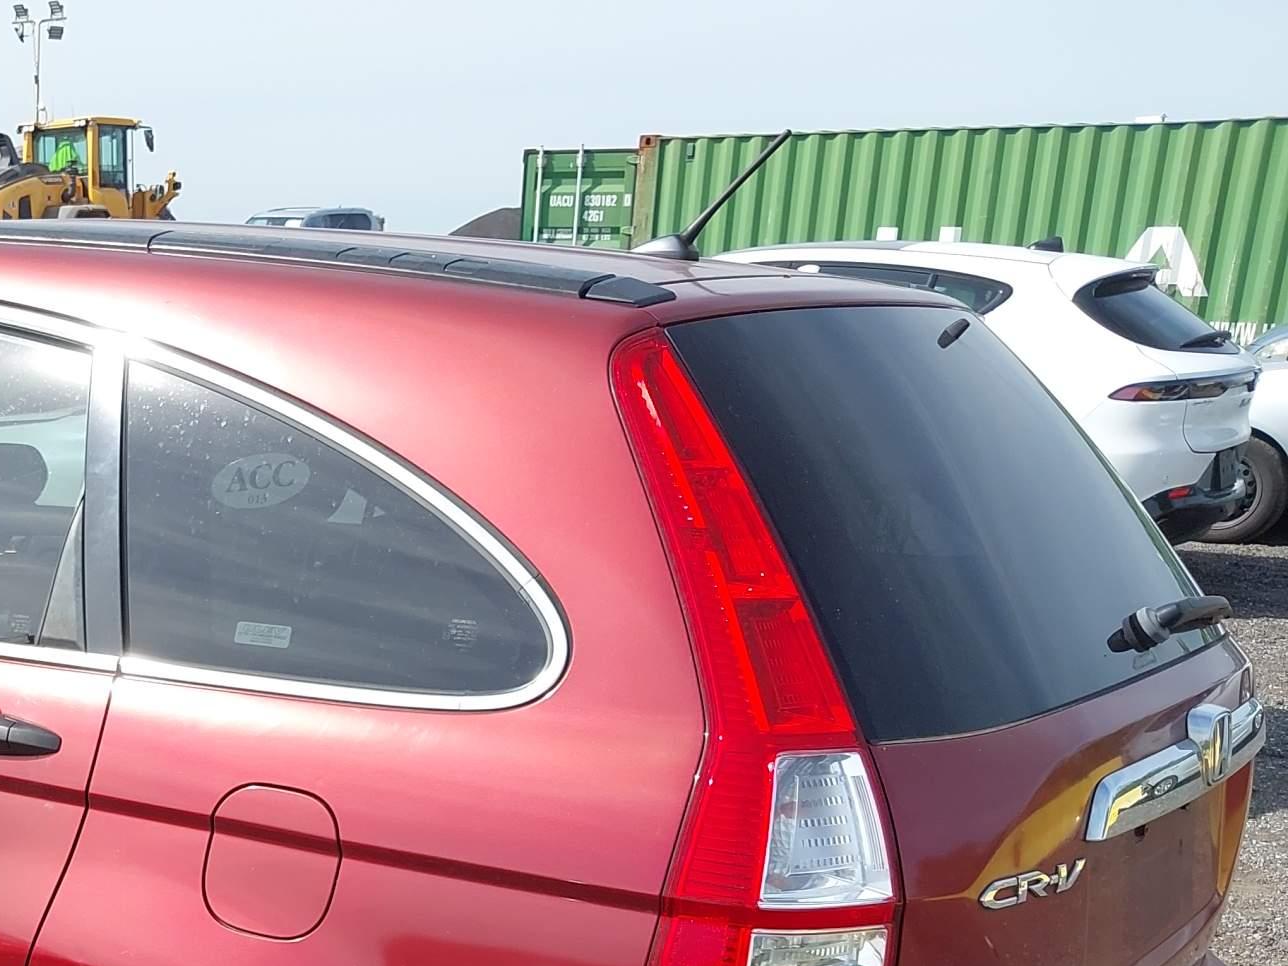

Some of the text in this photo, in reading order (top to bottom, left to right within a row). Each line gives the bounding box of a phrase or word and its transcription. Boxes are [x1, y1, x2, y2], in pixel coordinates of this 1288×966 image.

[549, 194, 574, 208] UACU
[584, 194, 618, 207] 830182
[225, 460, 296, 493] ACC
[978, 858, 1087, 911] CR-V
